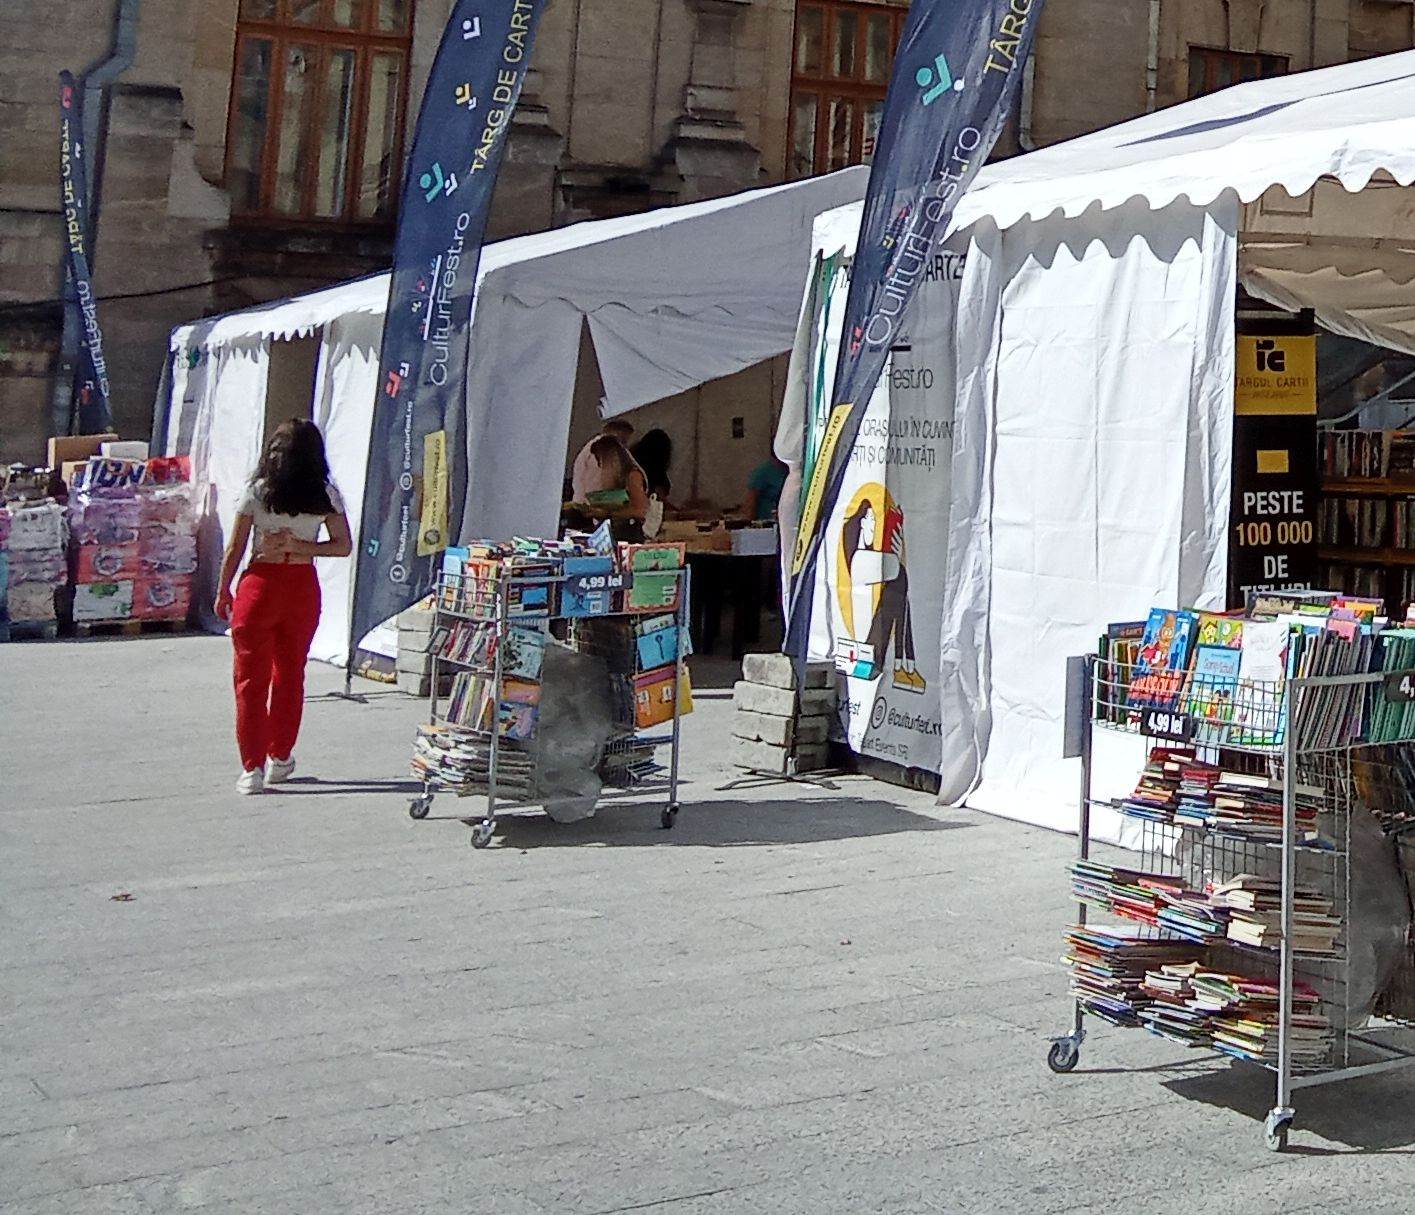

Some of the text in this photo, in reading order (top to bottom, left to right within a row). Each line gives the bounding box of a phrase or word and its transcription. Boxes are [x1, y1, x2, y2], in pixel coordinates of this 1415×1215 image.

[470, 108, 504, 174] TÂRG
[494, 68, 518, 104] DE
[430, 212, 471, 387] CulturFest.ro
[1243, 490, 1304, 515] PESTE
[1236, 520, 1313, 546] 100 000
[1263, 554, 1289, 579] DE
[579, 574, 623, 590] 4,99 lei
[1148, 713, 1183, 735] 4,99 lei
